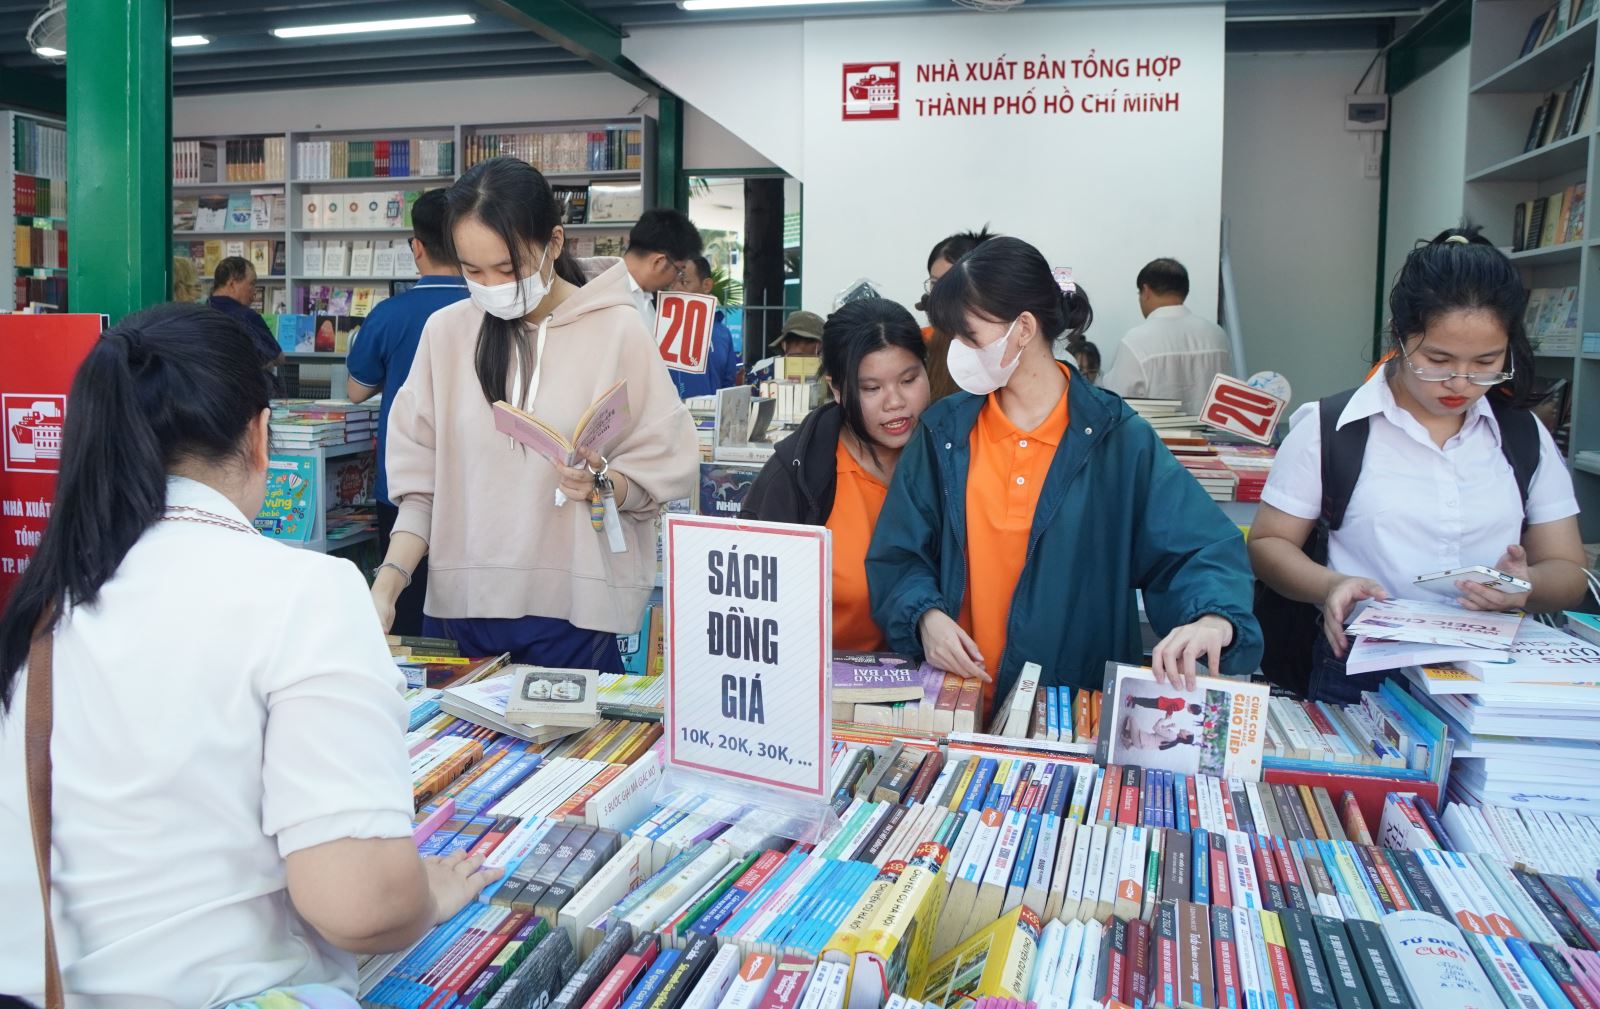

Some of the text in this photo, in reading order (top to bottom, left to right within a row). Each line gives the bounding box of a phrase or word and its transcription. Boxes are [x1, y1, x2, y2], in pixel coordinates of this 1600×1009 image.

[916, 48, 1182, 83] NHÀ XUẤT BẢN TỔNG HỢP
[916, 85, 1180, 116] THÀNH PHỐ HỒ CHÍ MINH
[659, 297, 707, 366] 20
[1208, 384, 1277, 436] 20
[3, 496, 51, 518] NHÀ XUẤT
[15, 525, 41, 546] TỔNG
[2, 557, 15, 573] TP.
[708, 545, 778, 602] SÁCH
[707, 607, 779, 665] ĐỒNG
[1432, 620, 1501, 633] TOEIC
[1511, 647, 1600, 656] Writin
[721, 673, 765, 725] GIÁ
[1232, 693, 1245, 725] GIAO
[681, 727, 715, 748] 10K,
[718, 734, 752, 756] 20K,
[757, 742, 793, 764] 30K,
